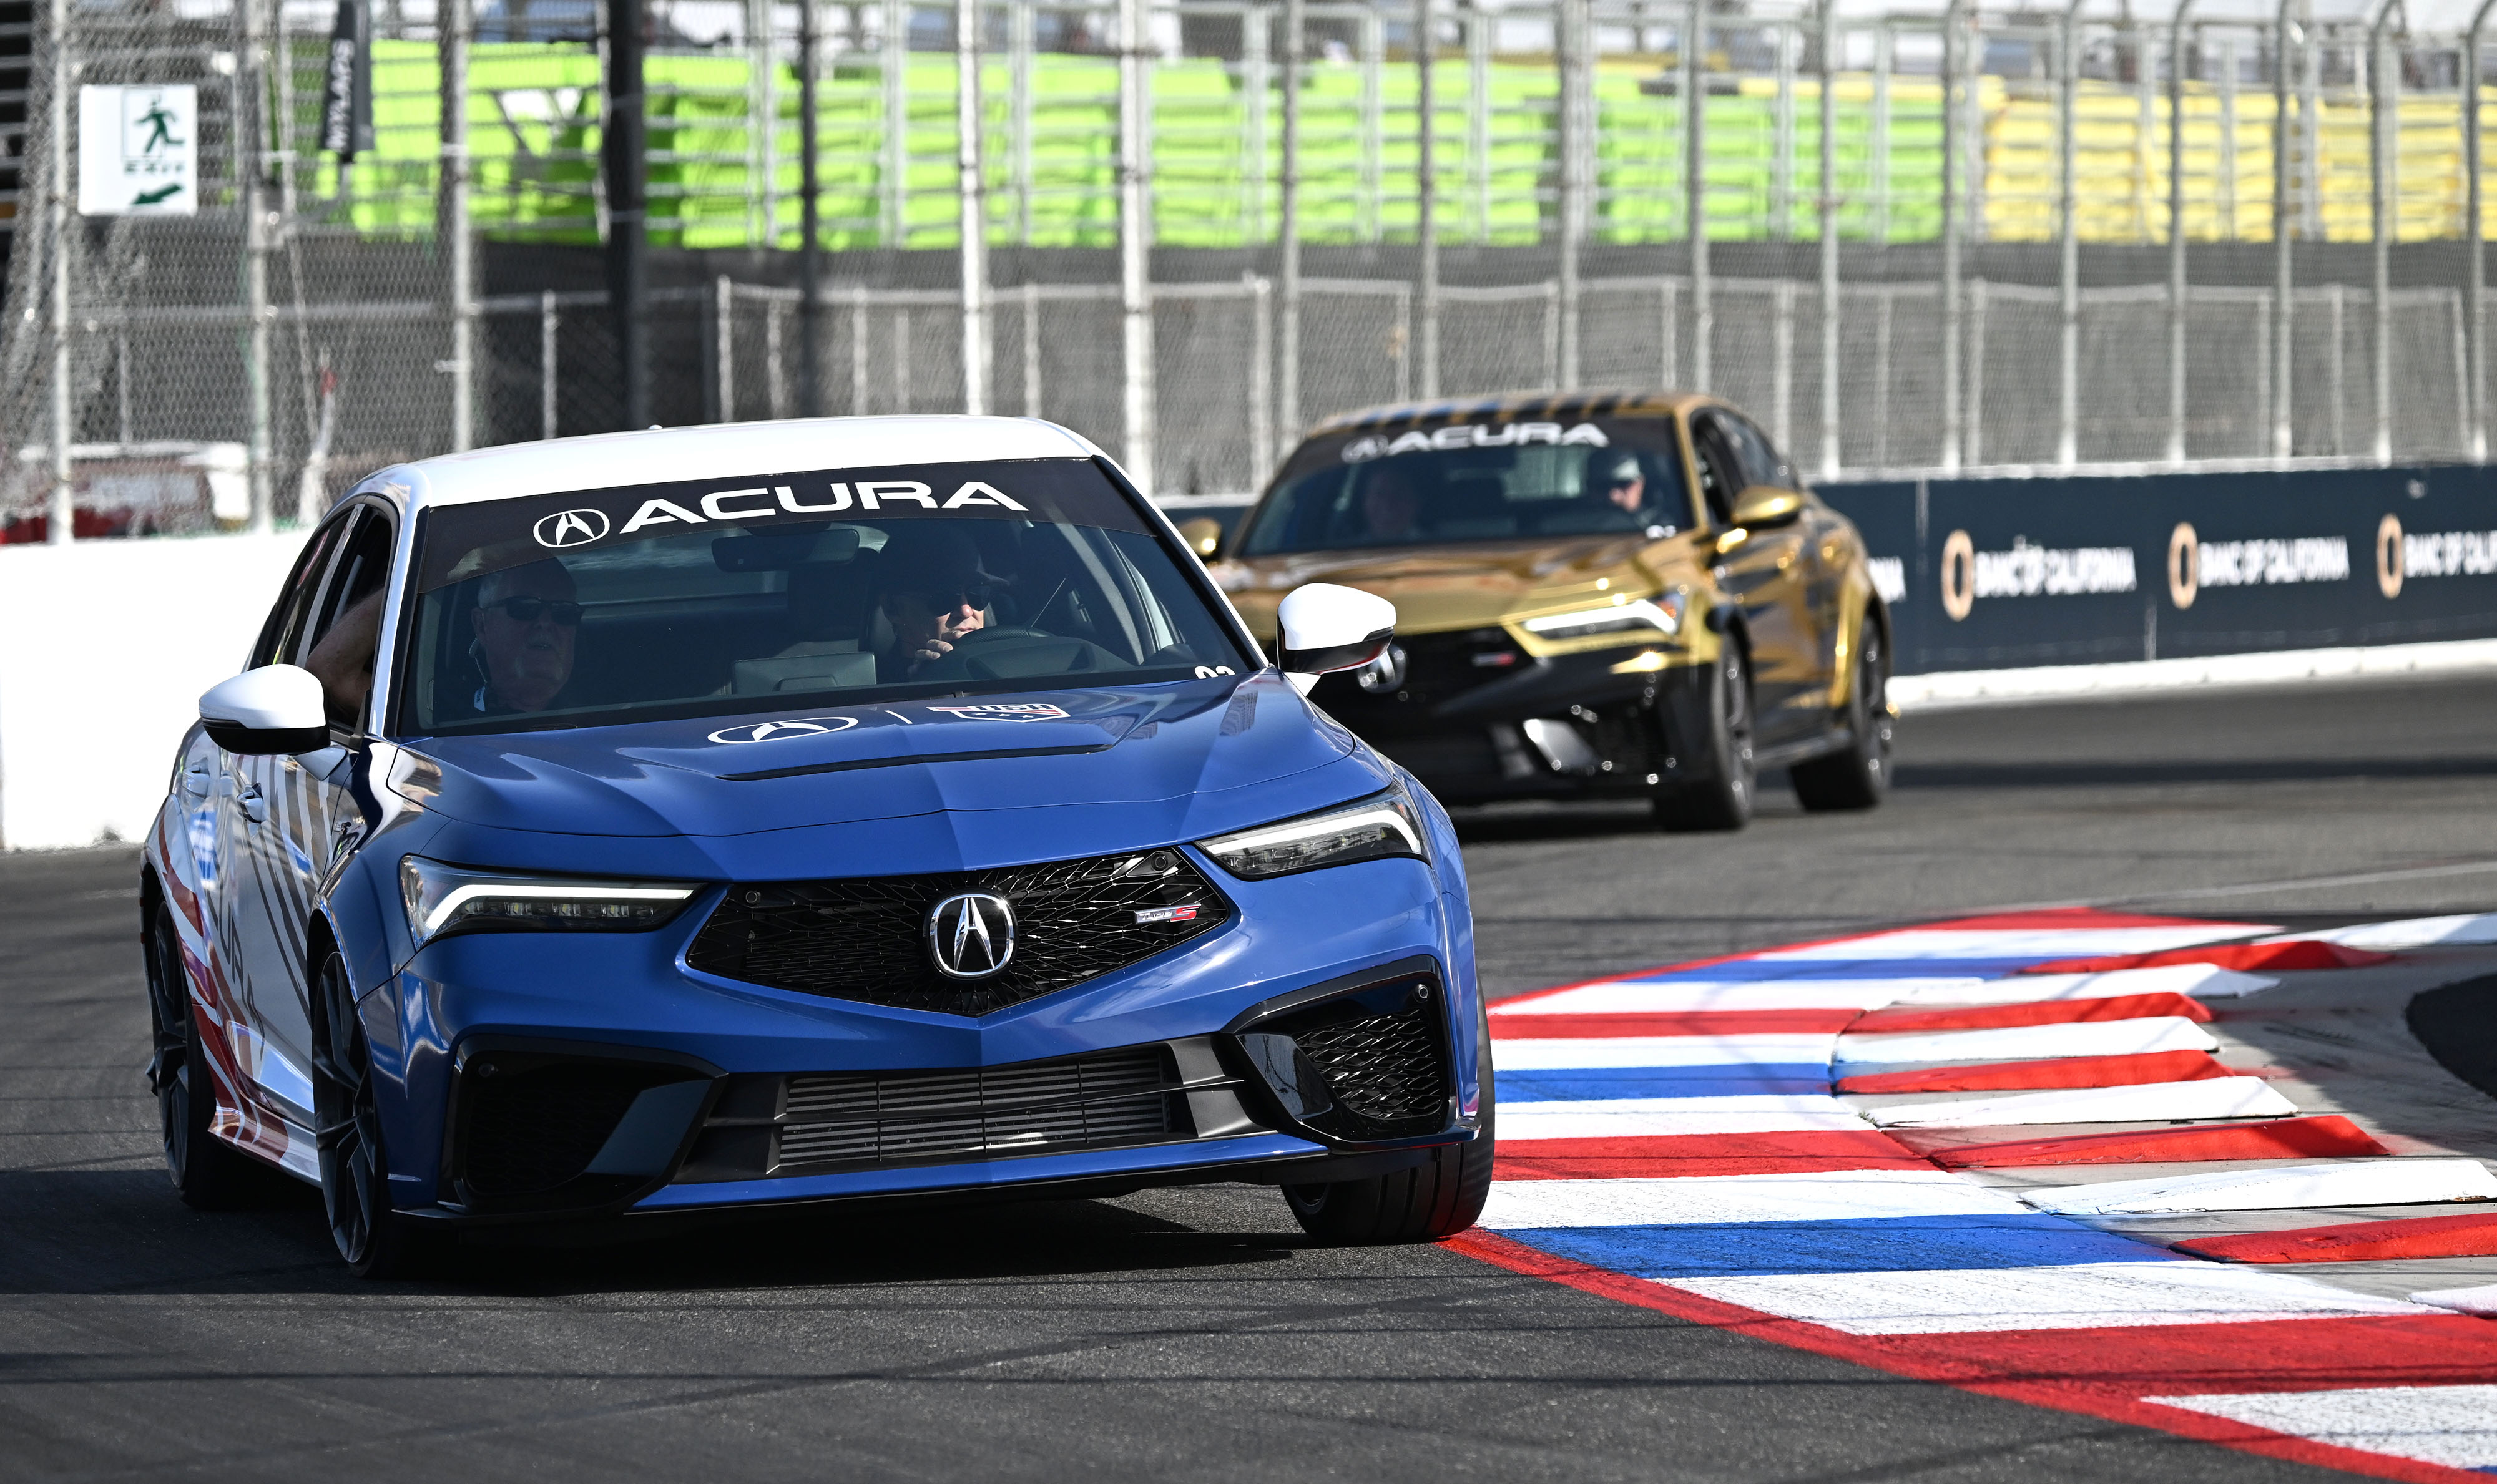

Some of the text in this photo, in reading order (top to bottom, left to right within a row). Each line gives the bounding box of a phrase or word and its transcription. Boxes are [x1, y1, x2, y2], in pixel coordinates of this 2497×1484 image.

[1386, 422, 1610, 456] ACURA
[619, 481, 1030, 534] ACURA
[1170, 905, 1200, 922] S
